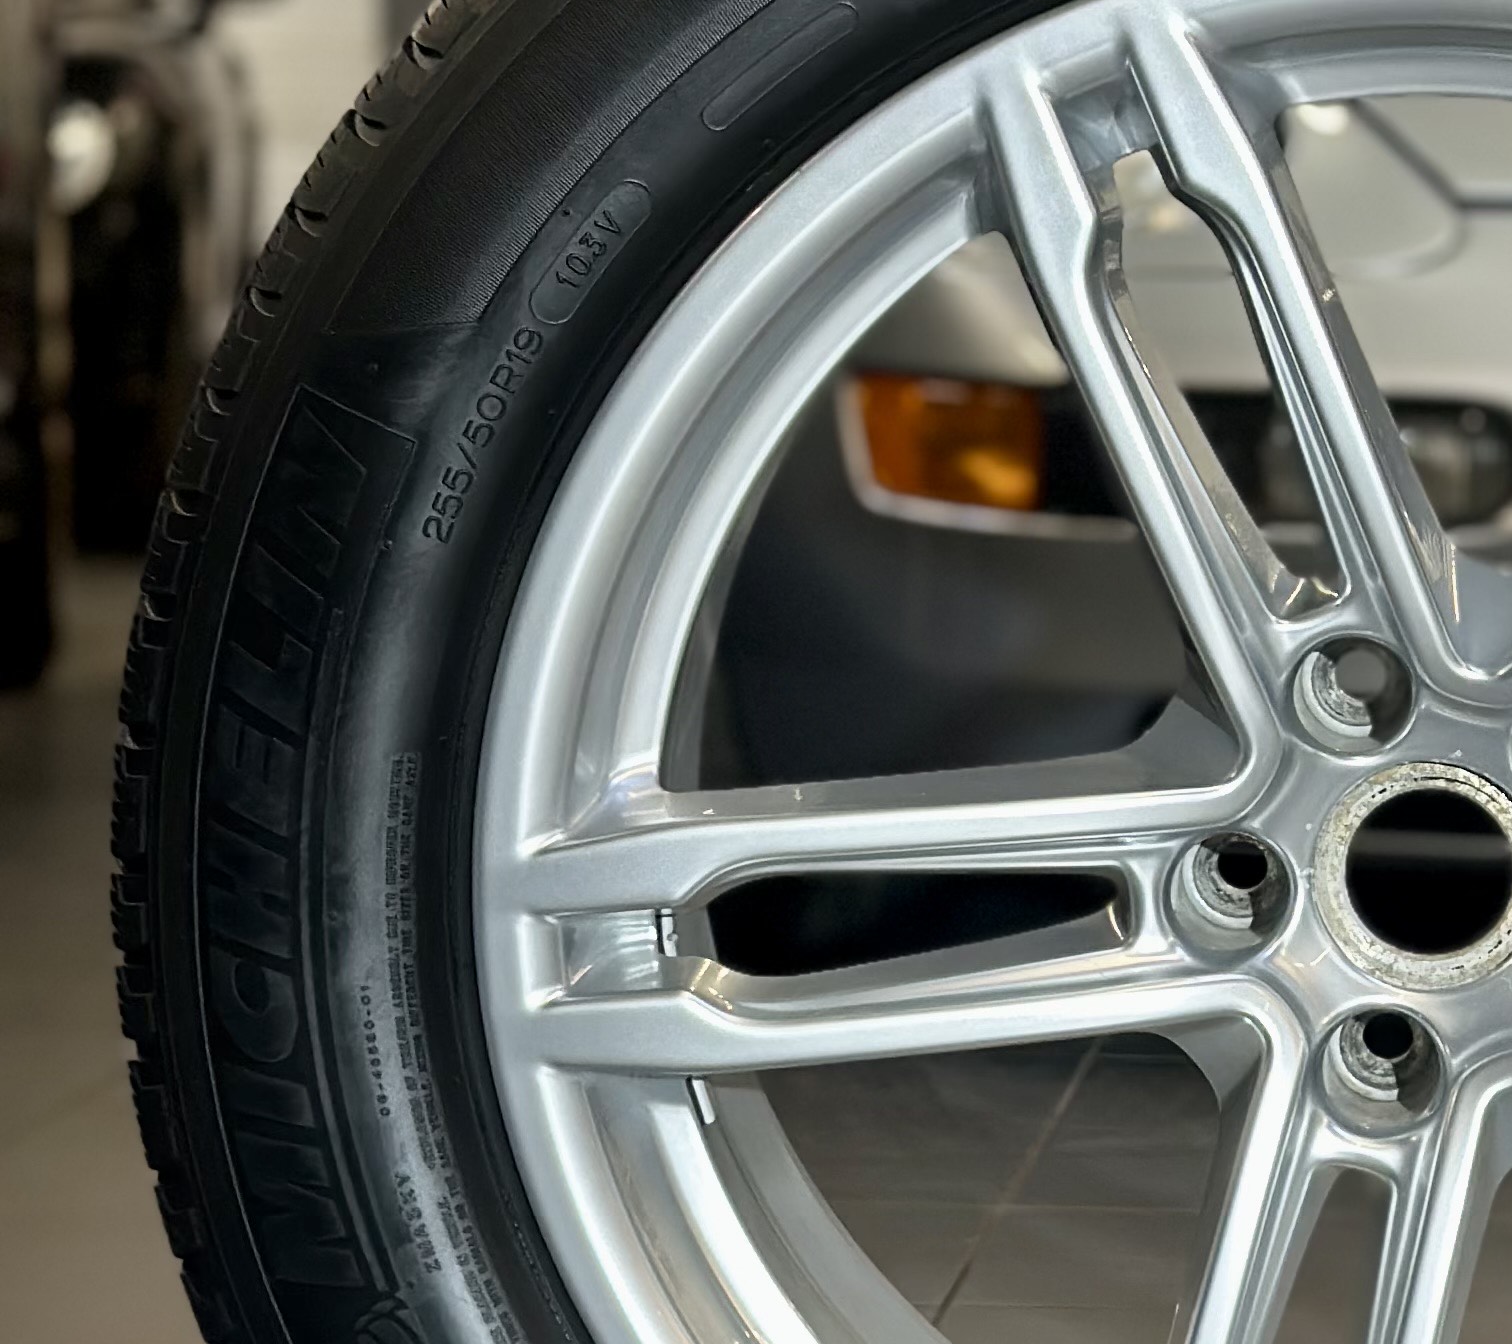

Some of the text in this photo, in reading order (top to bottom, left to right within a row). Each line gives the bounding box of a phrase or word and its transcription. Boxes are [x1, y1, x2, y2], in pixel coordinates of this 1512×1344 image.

[419, 207, 627, 545] 255/50R19 103V
[209, 401, 367, 1285] MICHELIN
